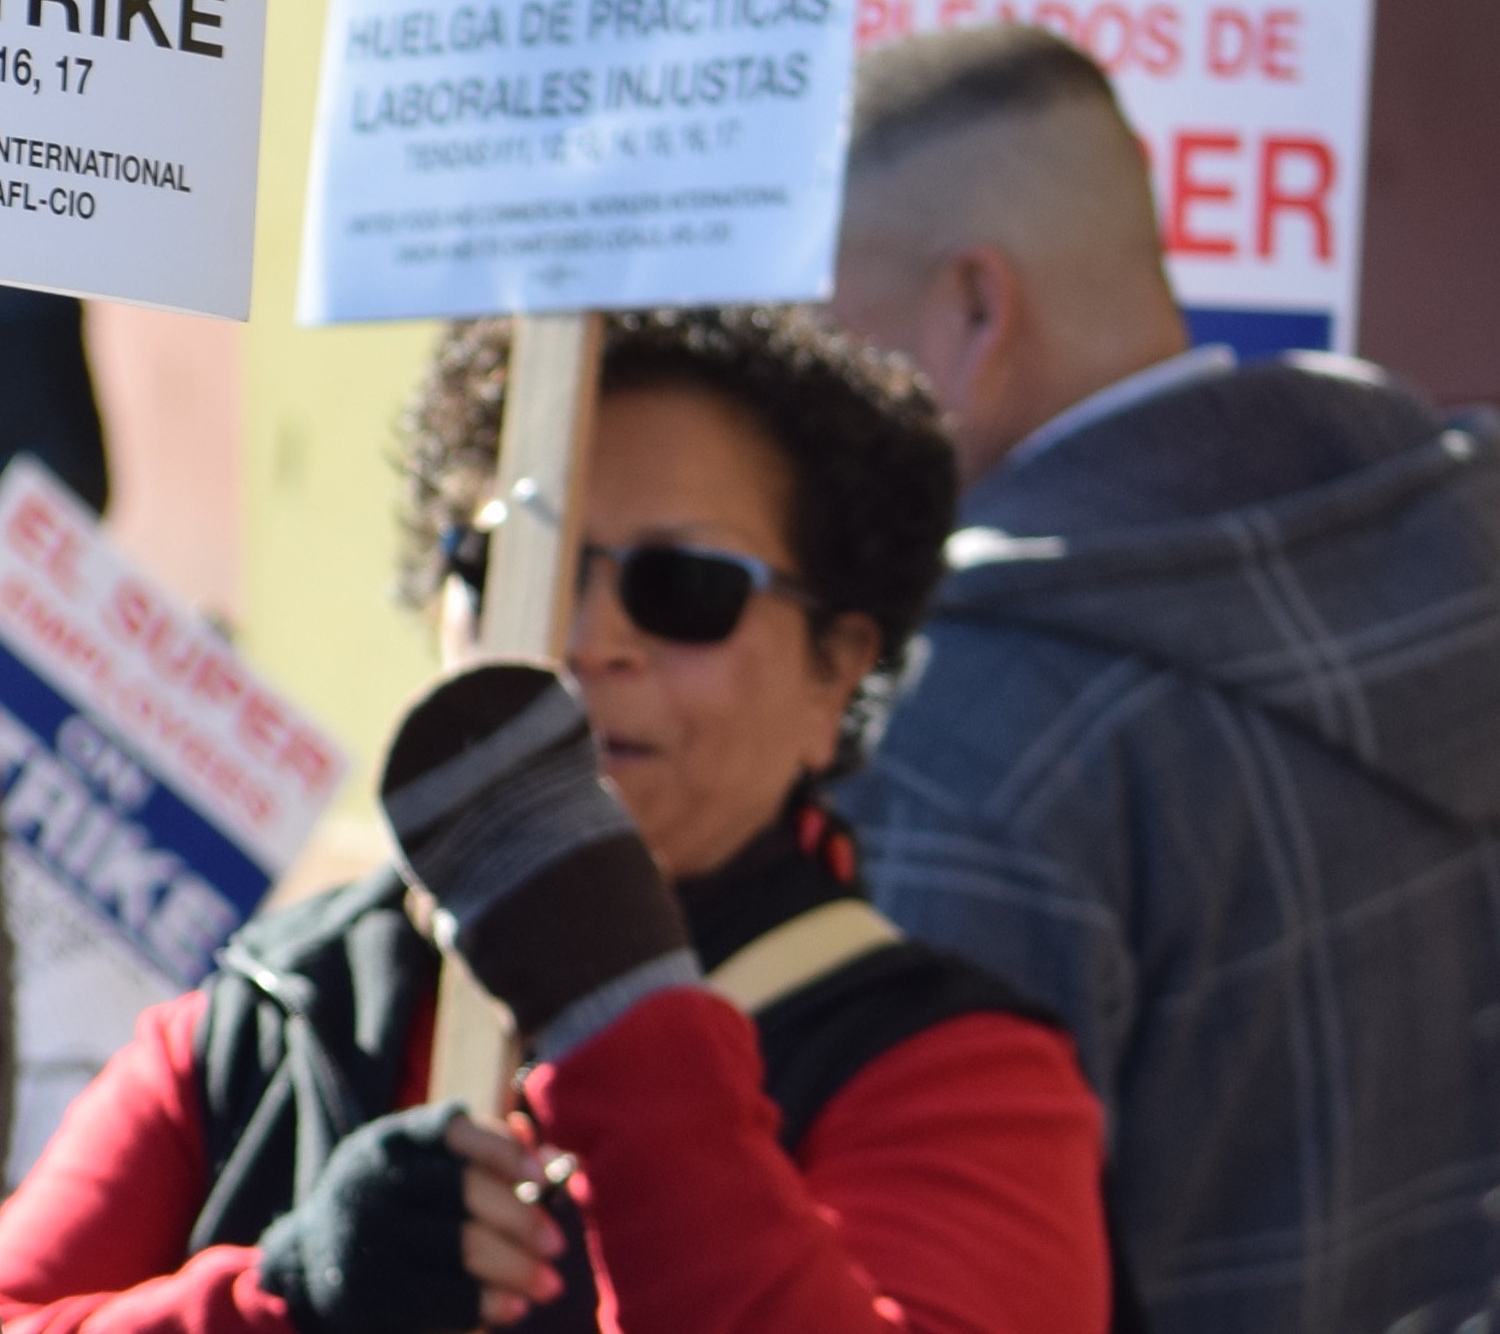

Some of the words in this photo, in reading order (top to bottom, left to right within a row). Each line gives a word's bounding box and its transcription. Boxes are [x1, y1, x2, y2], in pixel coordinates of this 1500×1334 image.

[349, 7, 506, 65] HUELGA
[1207, 7, 1303, 81] DE
[56, 56, 93, 94] 17
[353, 65, 591, 133] LABORALES
[603, 51, 810, 108] INJUSTAS
[6, 493, 87, 599] EL
[106, 574, 333, 793] SUPER
